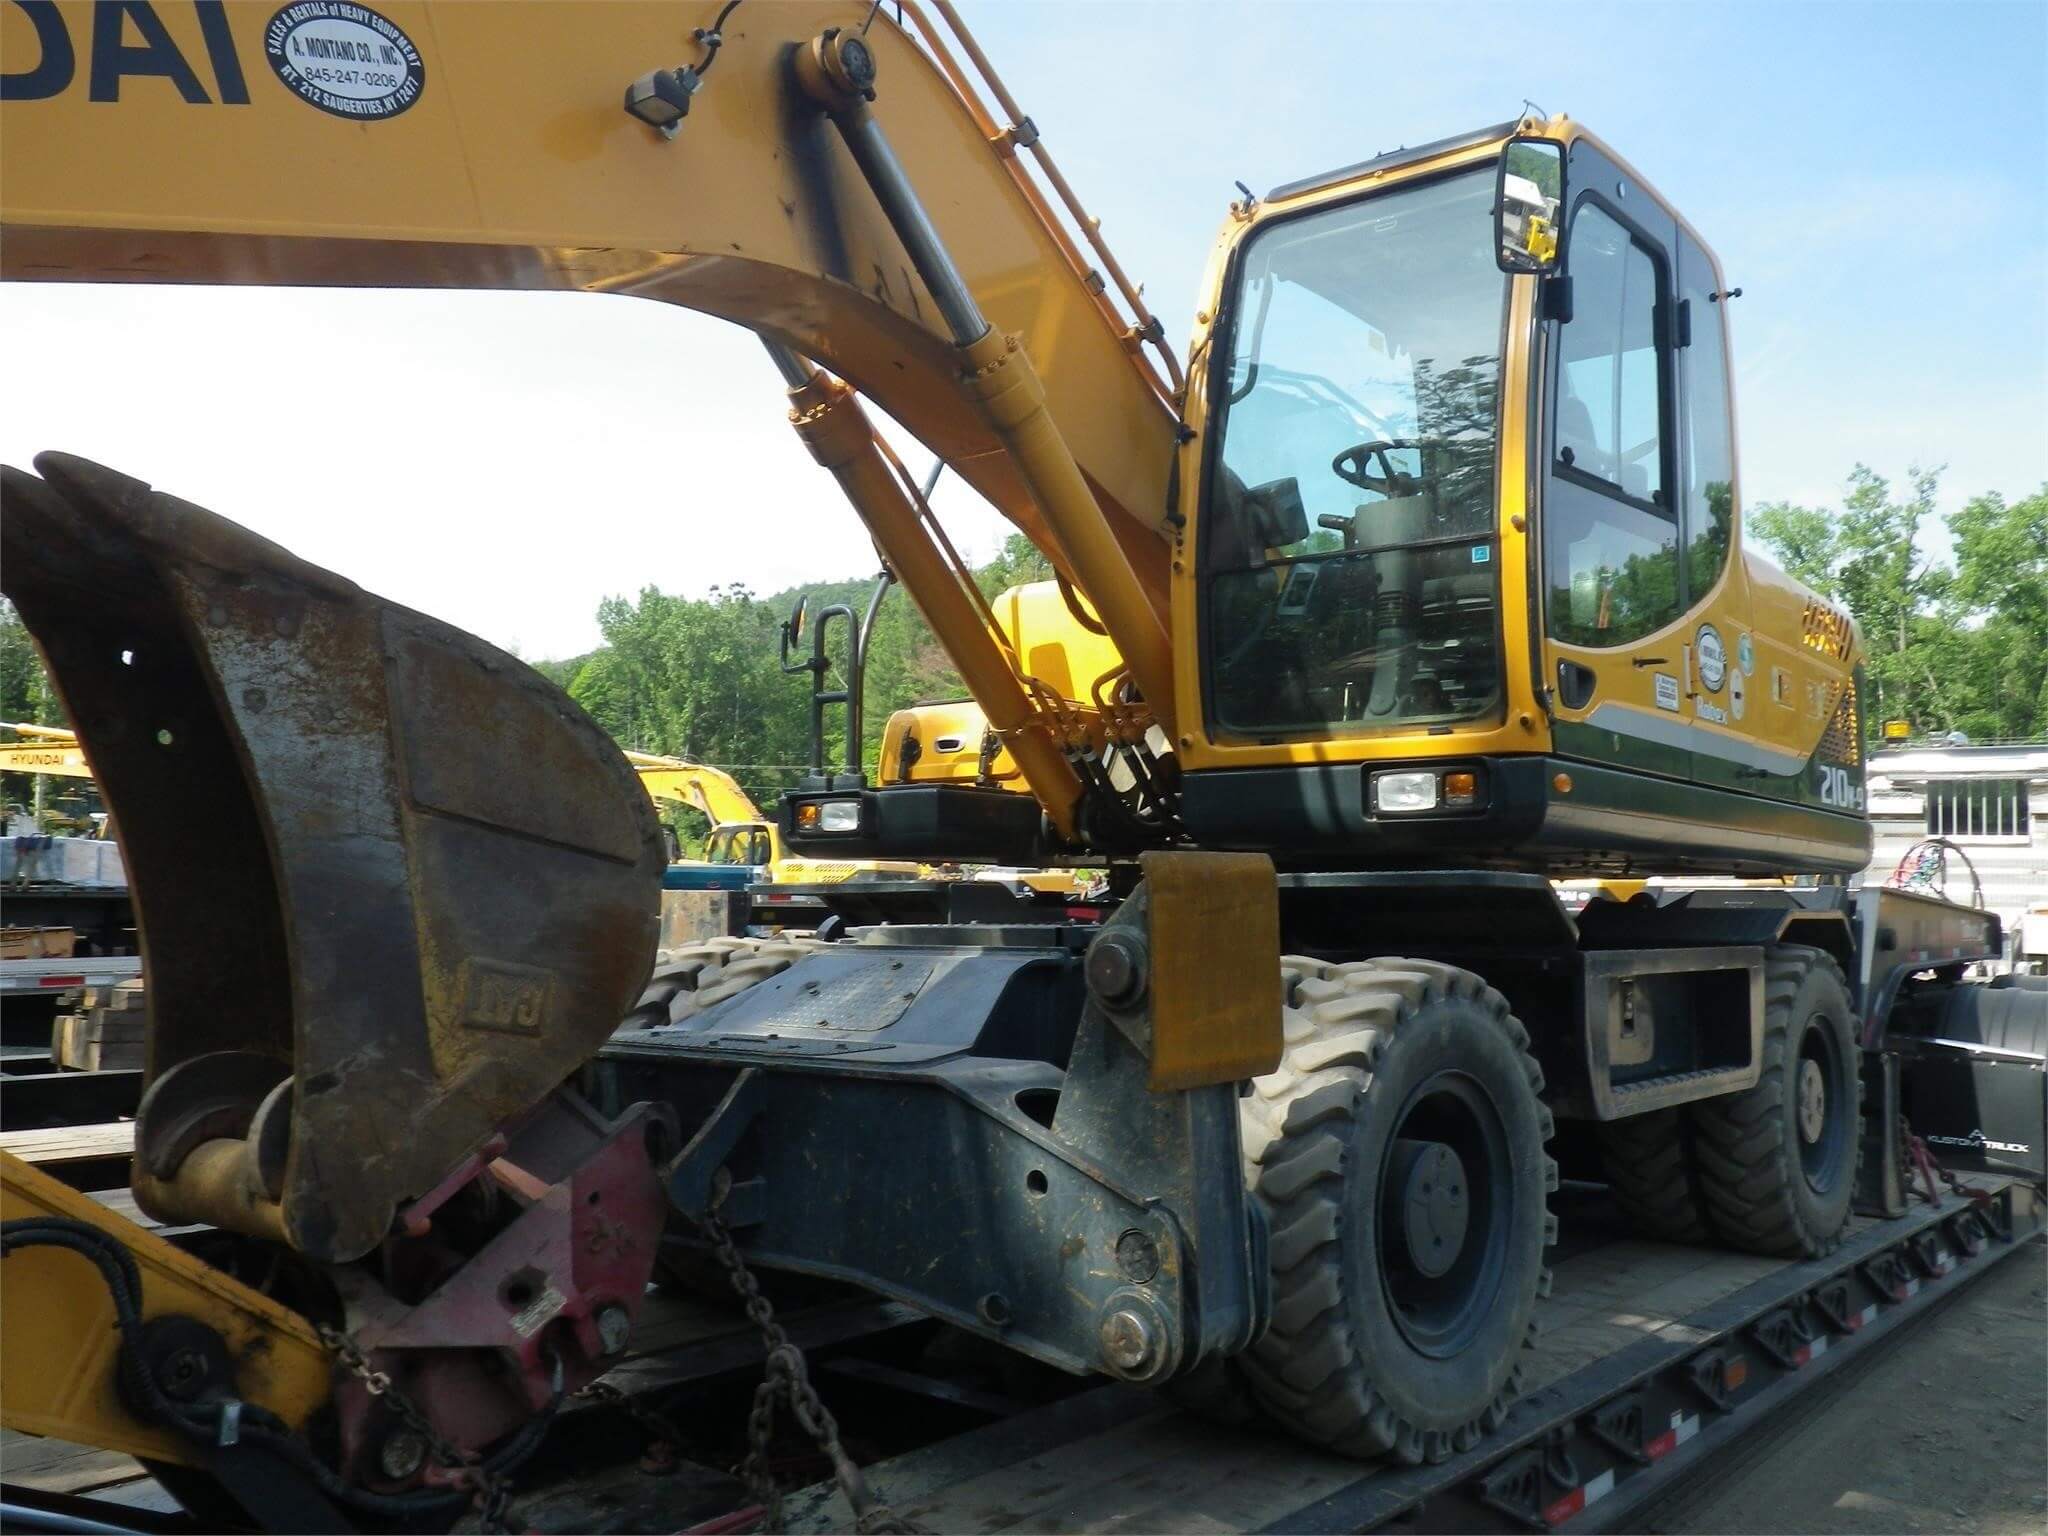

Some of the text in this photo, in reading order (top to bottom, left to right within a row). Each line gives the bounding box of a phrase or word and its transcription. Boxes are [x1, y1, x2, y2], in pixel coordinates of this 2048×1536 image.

[268, 20, 287, 55] SALES
[282, 13, 292, 26] &
[288, 2, 329, 23] RENTALS
[340, 4, 370, 23] HEAVY
[292, 36, 305, 56] A.
[305, 37, 356, 63] MONTANO
[380, 45, 402, 65] INC.
[280, 66, 297, 86] RT.
[299, 81, 321, 101] 212
[396, 75, 419, 105] 12477
[304, 67, 398, 88] 845-247-0206
[11, 754, 65, 765] HYUNDAI
